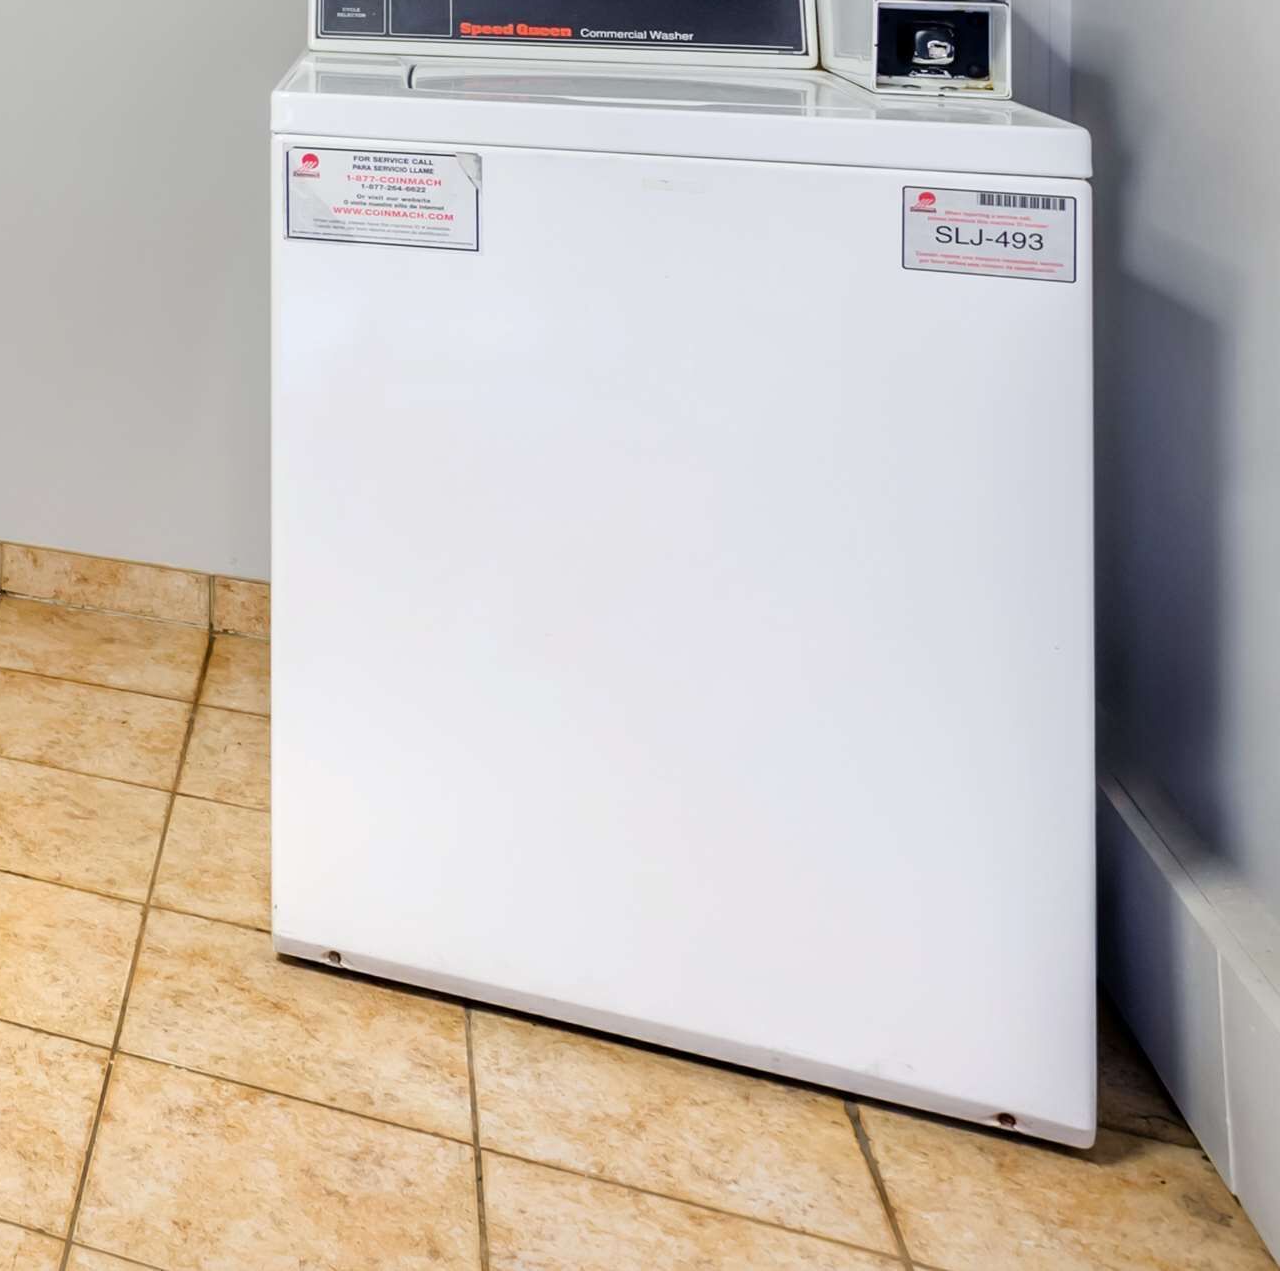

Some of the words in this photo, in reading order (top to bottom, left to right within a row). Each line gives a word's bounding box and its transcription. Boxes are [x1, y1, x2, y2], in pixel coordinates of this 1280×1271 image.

[459, 22, 514, 37] Speed
[516, 23, 573, 37] Queen
[579, 27, 647, 40] Commercial
[649, 30, 694, 41] Washer
[373, 156, 409, 165] SERVICE
[412, 158, 433, 166] CALL
[347, 174, 442, 186] 1-877-COINMACH
[333, 206, 454, 221] WWW.COINMACH.COM
[935, 225, 1044, 251] SLJ-493
